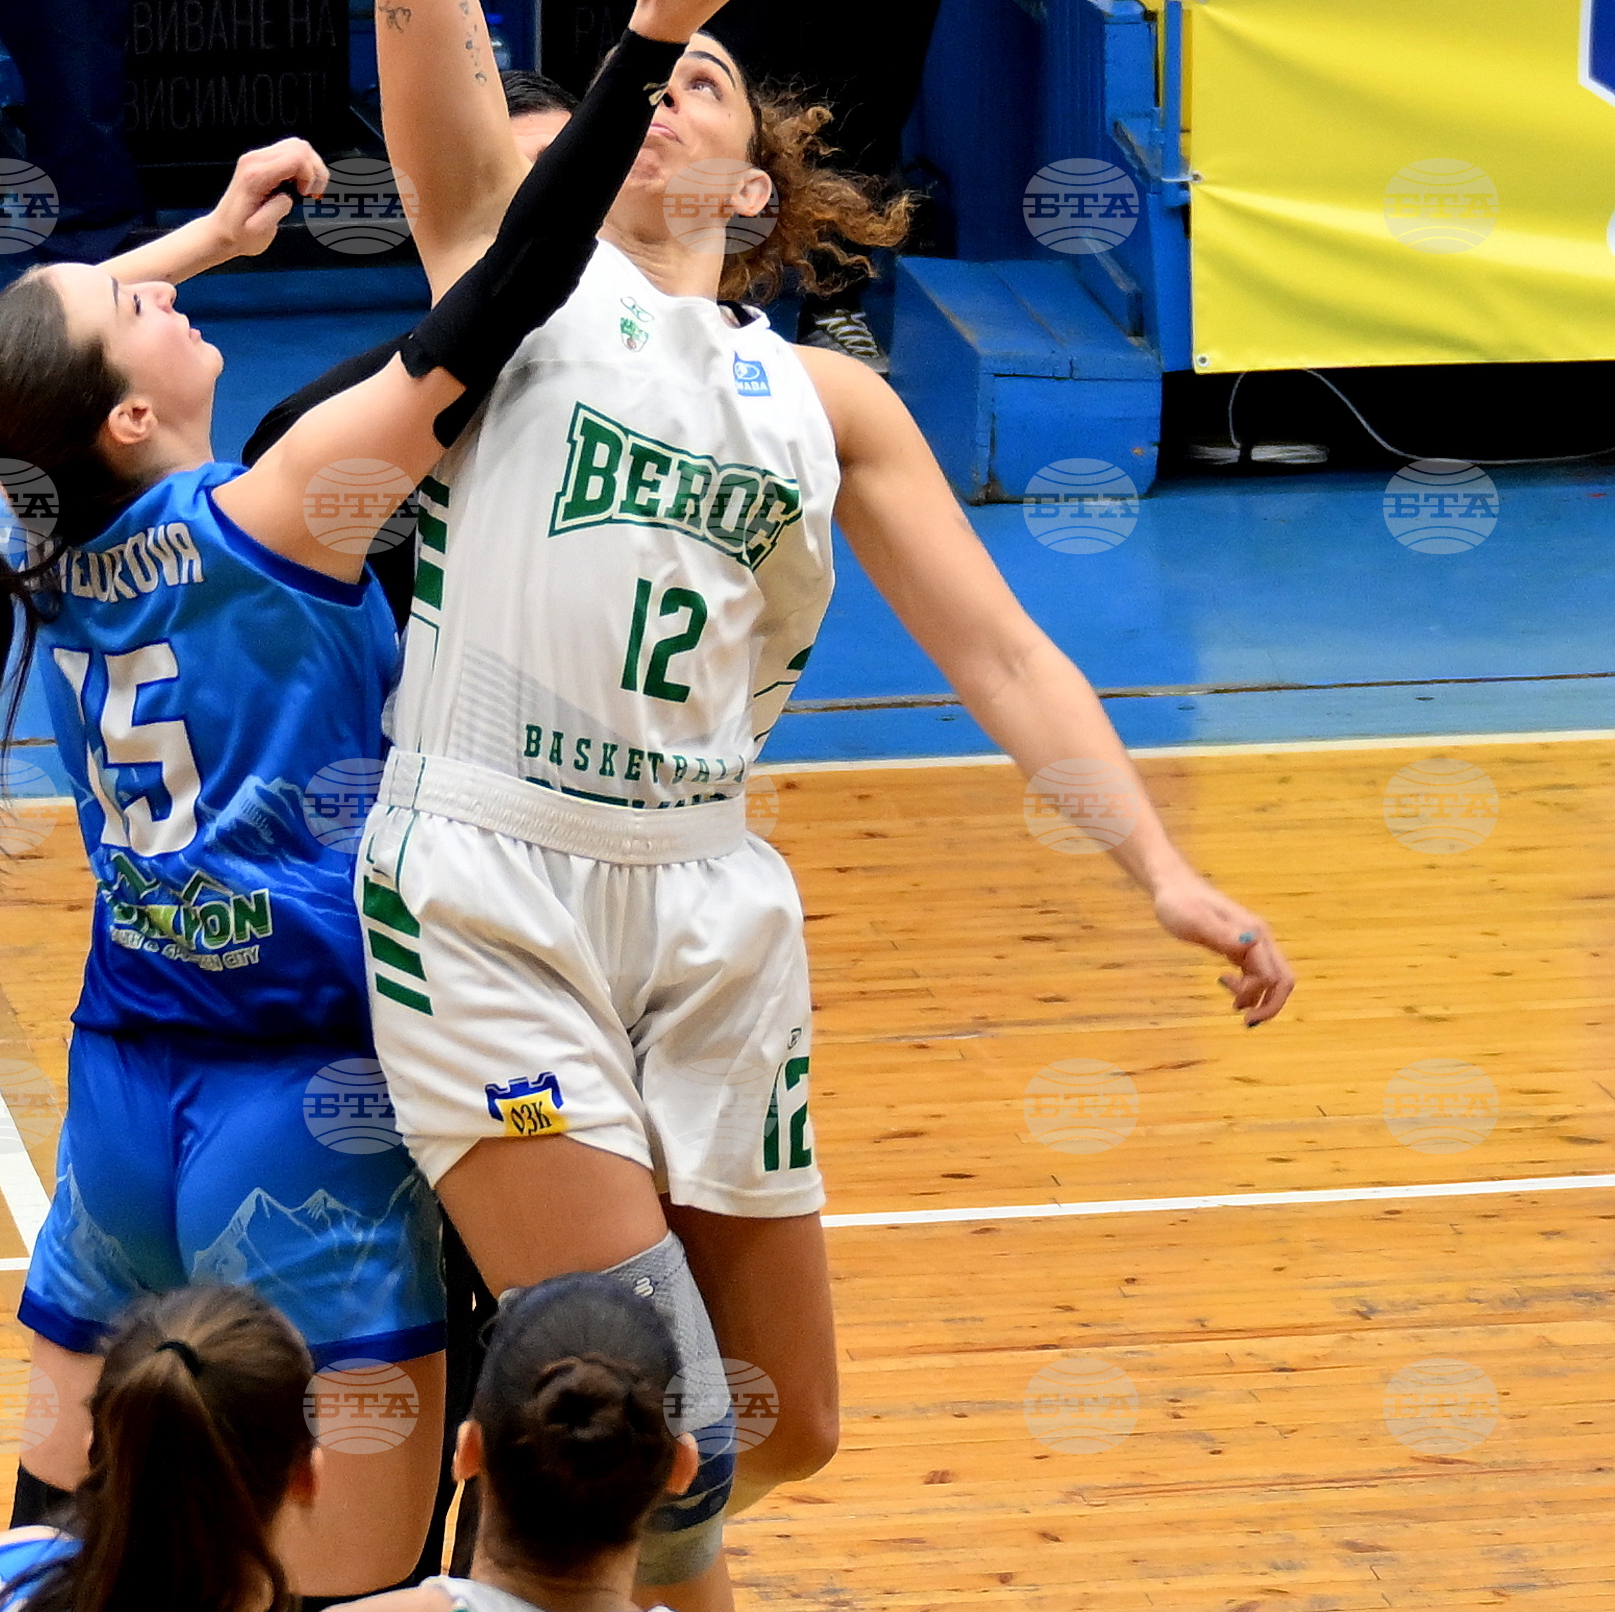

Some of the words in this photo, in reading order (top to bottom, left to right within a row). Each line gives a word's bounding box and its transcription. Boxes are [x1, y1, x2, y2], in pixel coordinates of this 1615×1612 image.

[125, 71, 328, 131] ВИСИМОСТ!
[620, 578, 709, 703] 12
[763, 1055, 813, 1172] 12
